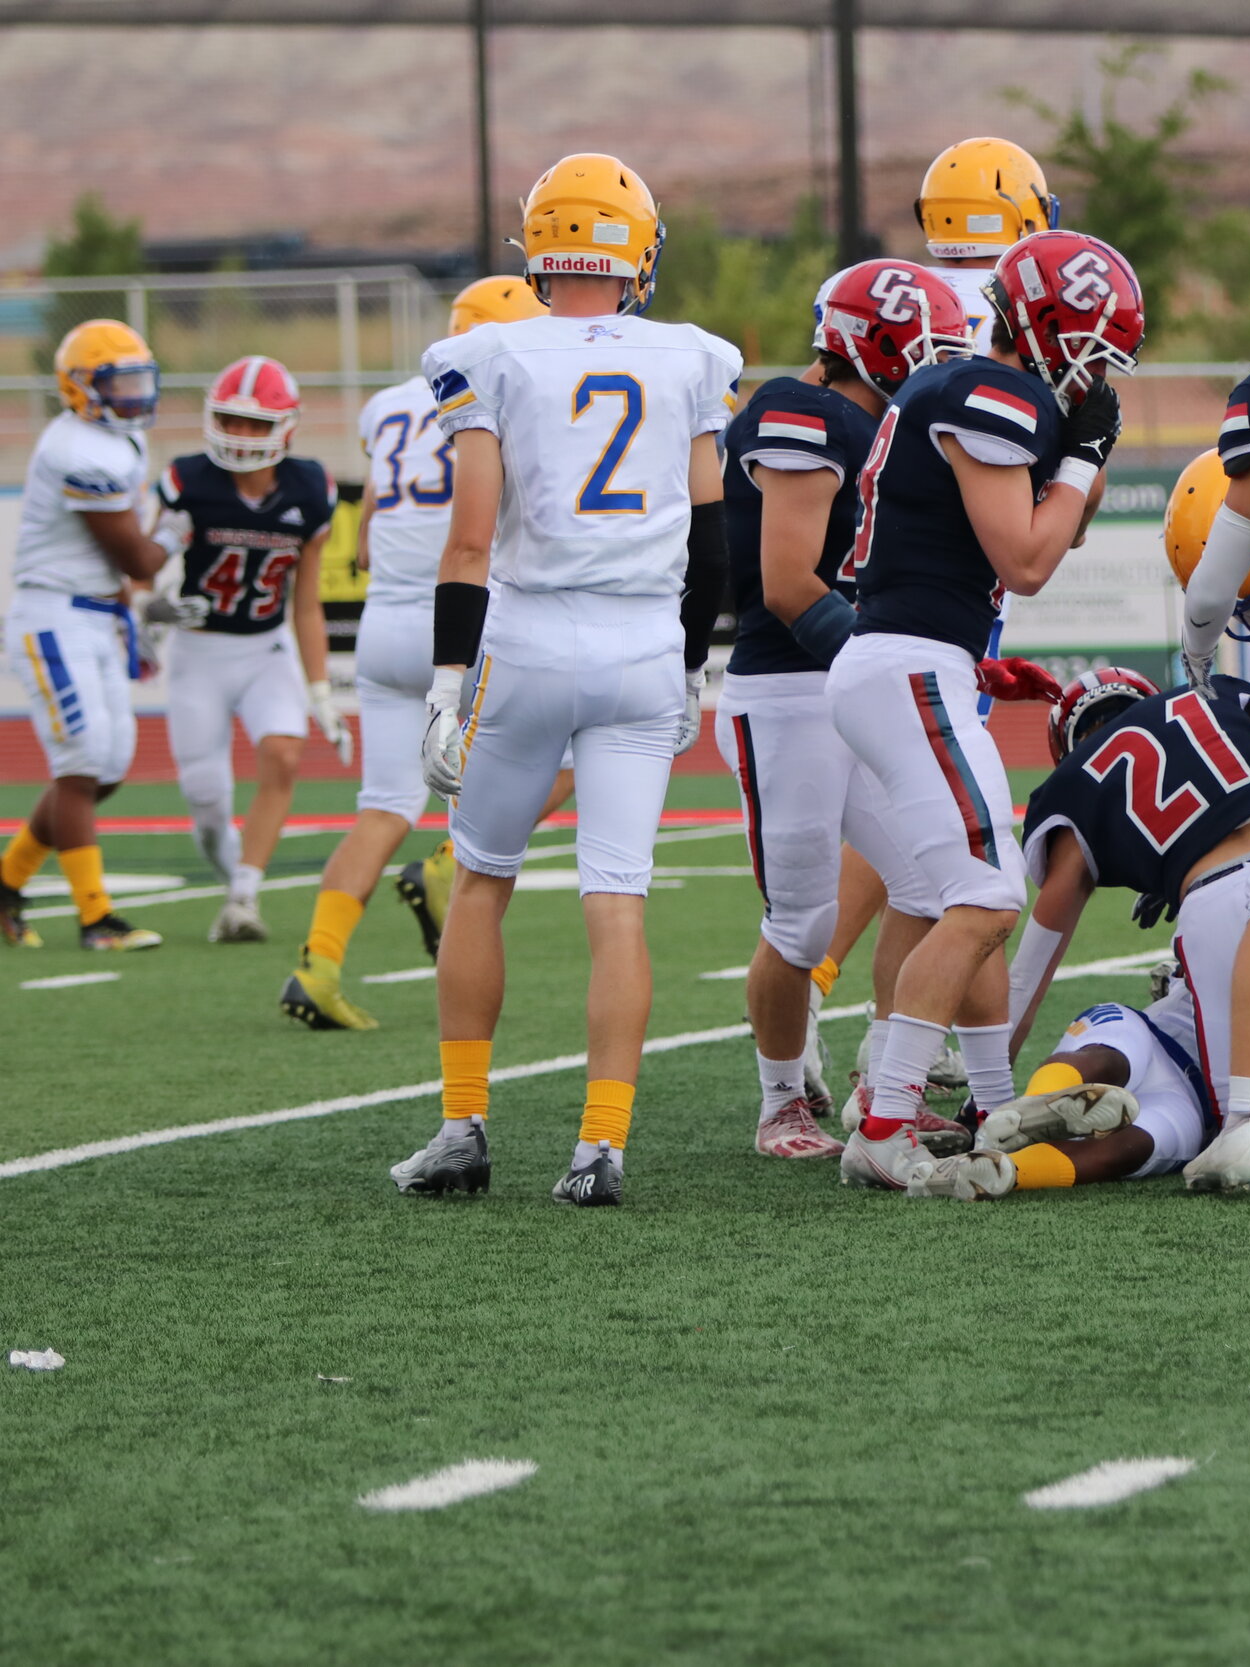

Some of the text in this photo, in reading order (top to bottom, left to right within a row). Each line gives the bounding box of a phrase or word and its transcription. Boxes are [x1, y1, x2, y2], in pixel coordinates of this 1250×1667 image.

[542, 256, 612, 273] Riddell
[375, 410, 455, 511] 33
[571, 371, 646, 515] 2
